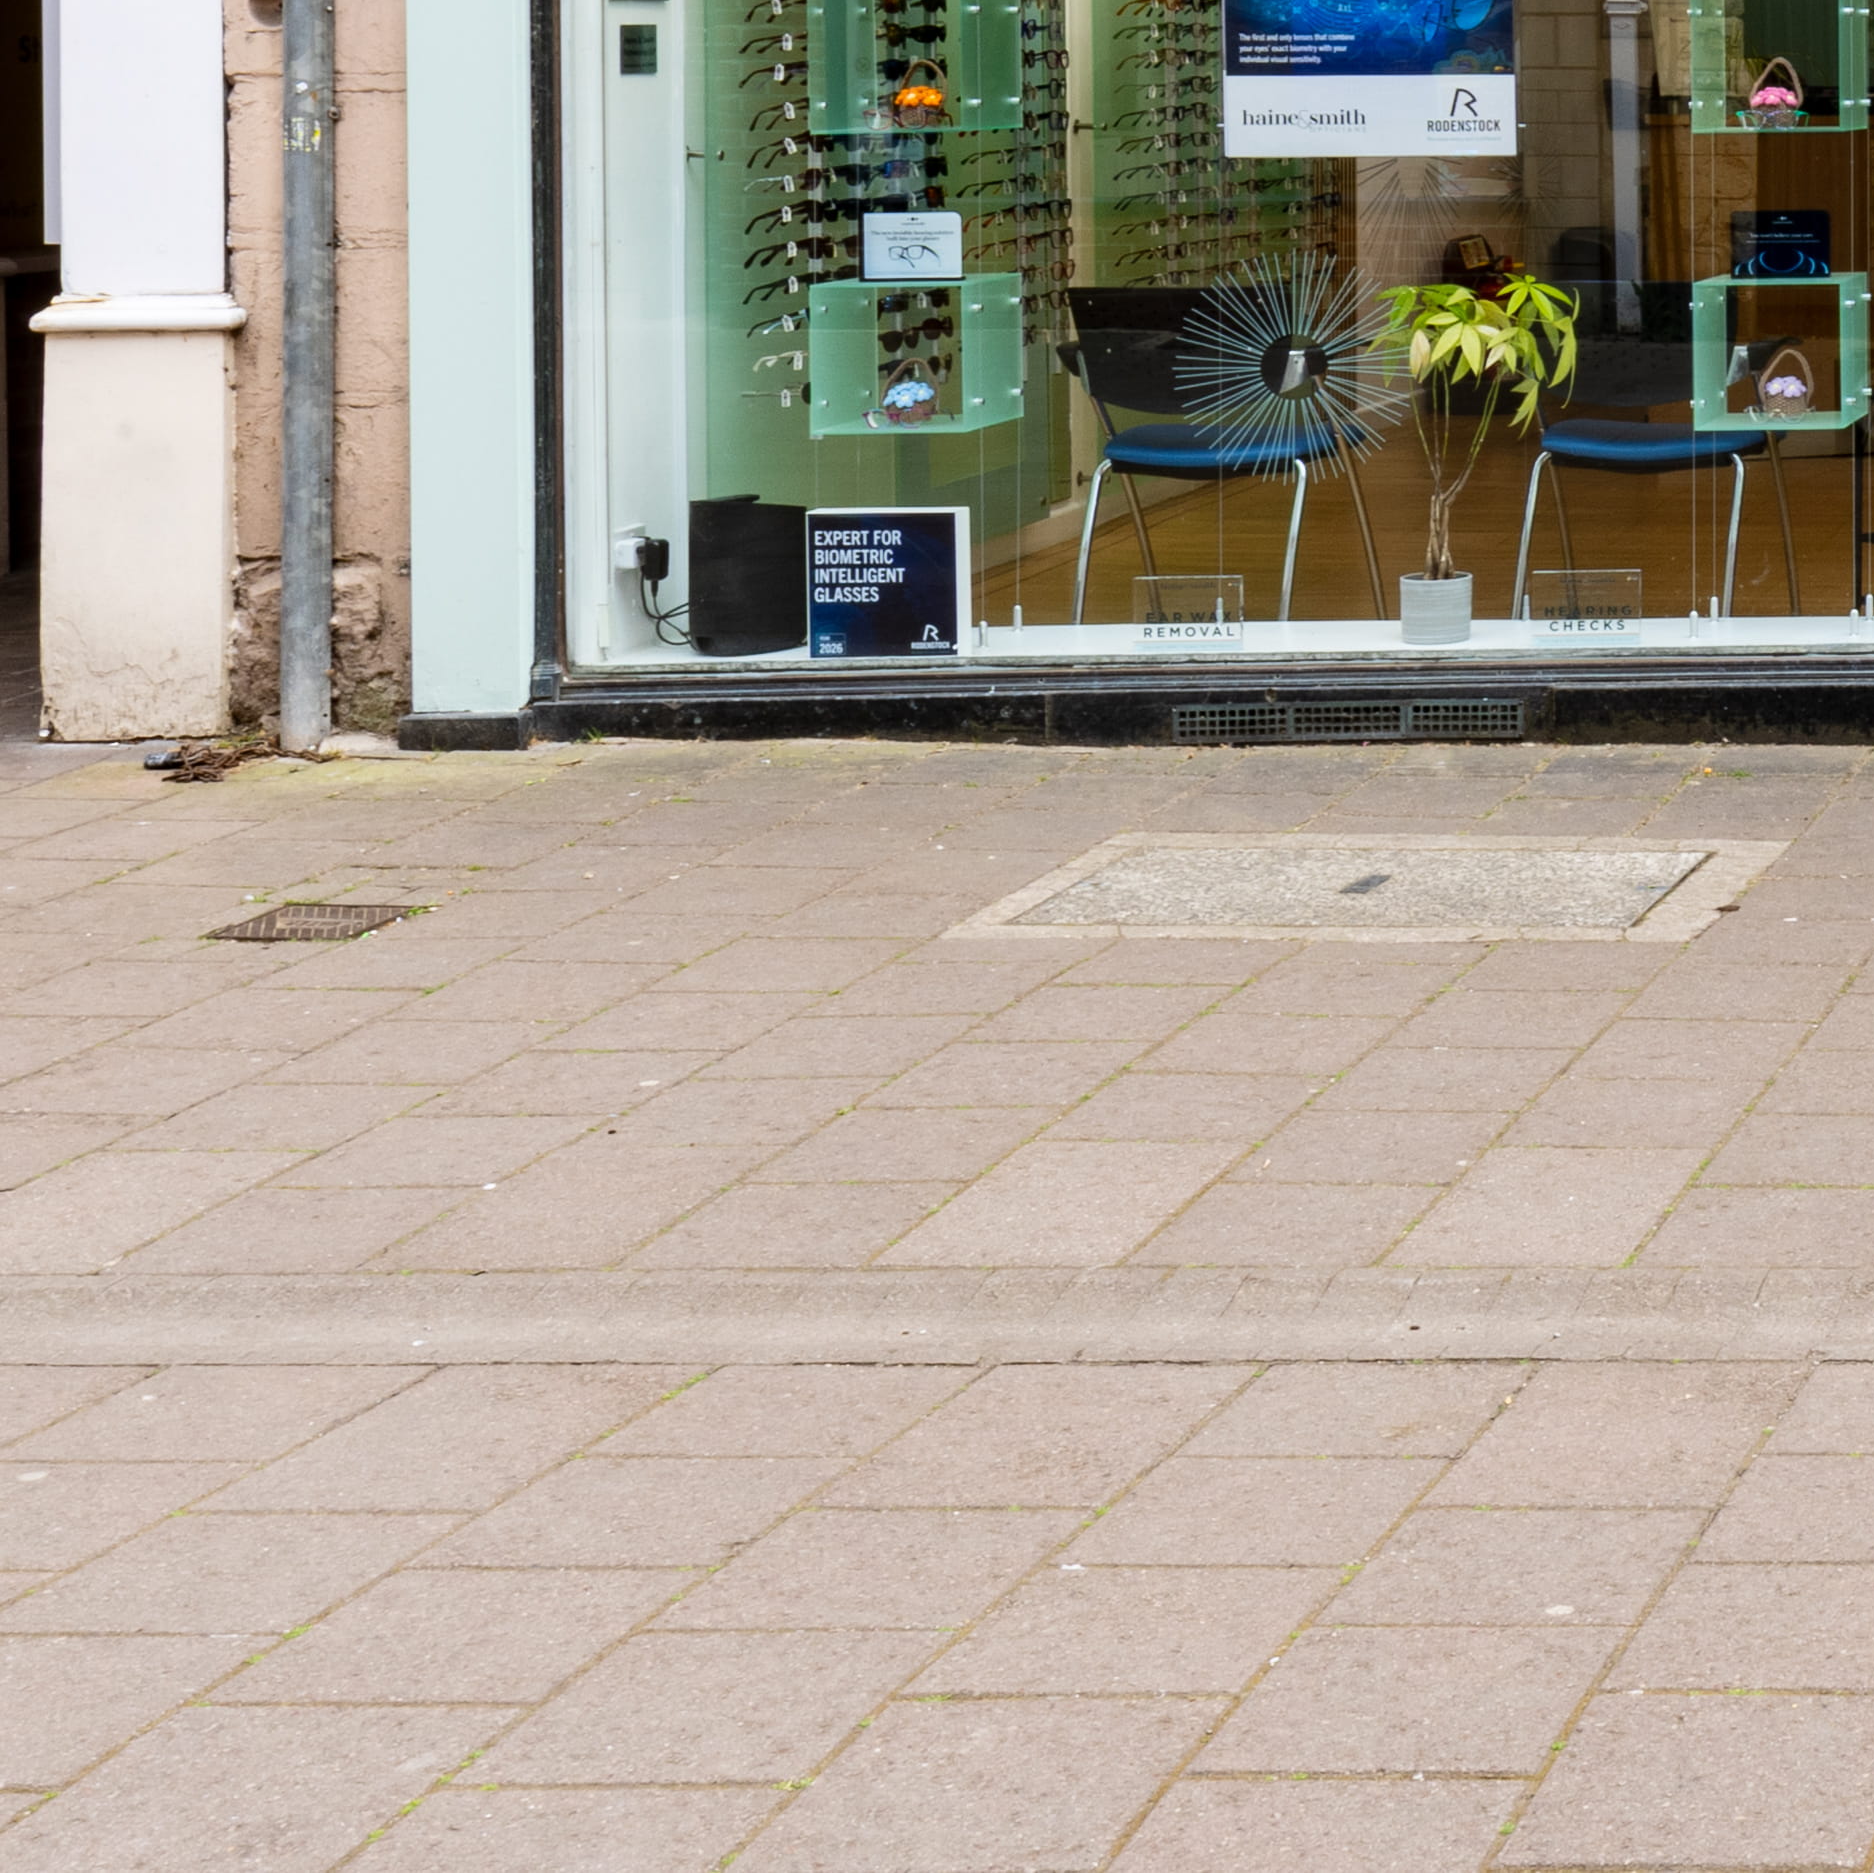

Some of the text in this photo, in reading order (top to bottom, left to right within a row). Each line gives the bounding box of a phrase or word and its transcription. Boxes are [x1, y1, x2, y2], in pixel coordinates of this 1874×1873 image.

[1242, 109, 1366, 130] haine&smith
[1427, 119, 1501, 132] RODENSTOCK
[814, 530, 902, 546] EXPERT FOR
[814, 549, 894, 565] BIOMETRIC
[814, 568, 905, 584] INTELLIGENT
[814, 587, 879, 603] GLASSES
[1146, 612, 1231, 623] EAR WAX
[1544, 606, 1632, 617] HEARING
[1144, 626, 1235, 638] REMOVAL
[1549, 620, 1626, 632] CHECKS
[819, 643, 843, 654] 2026
